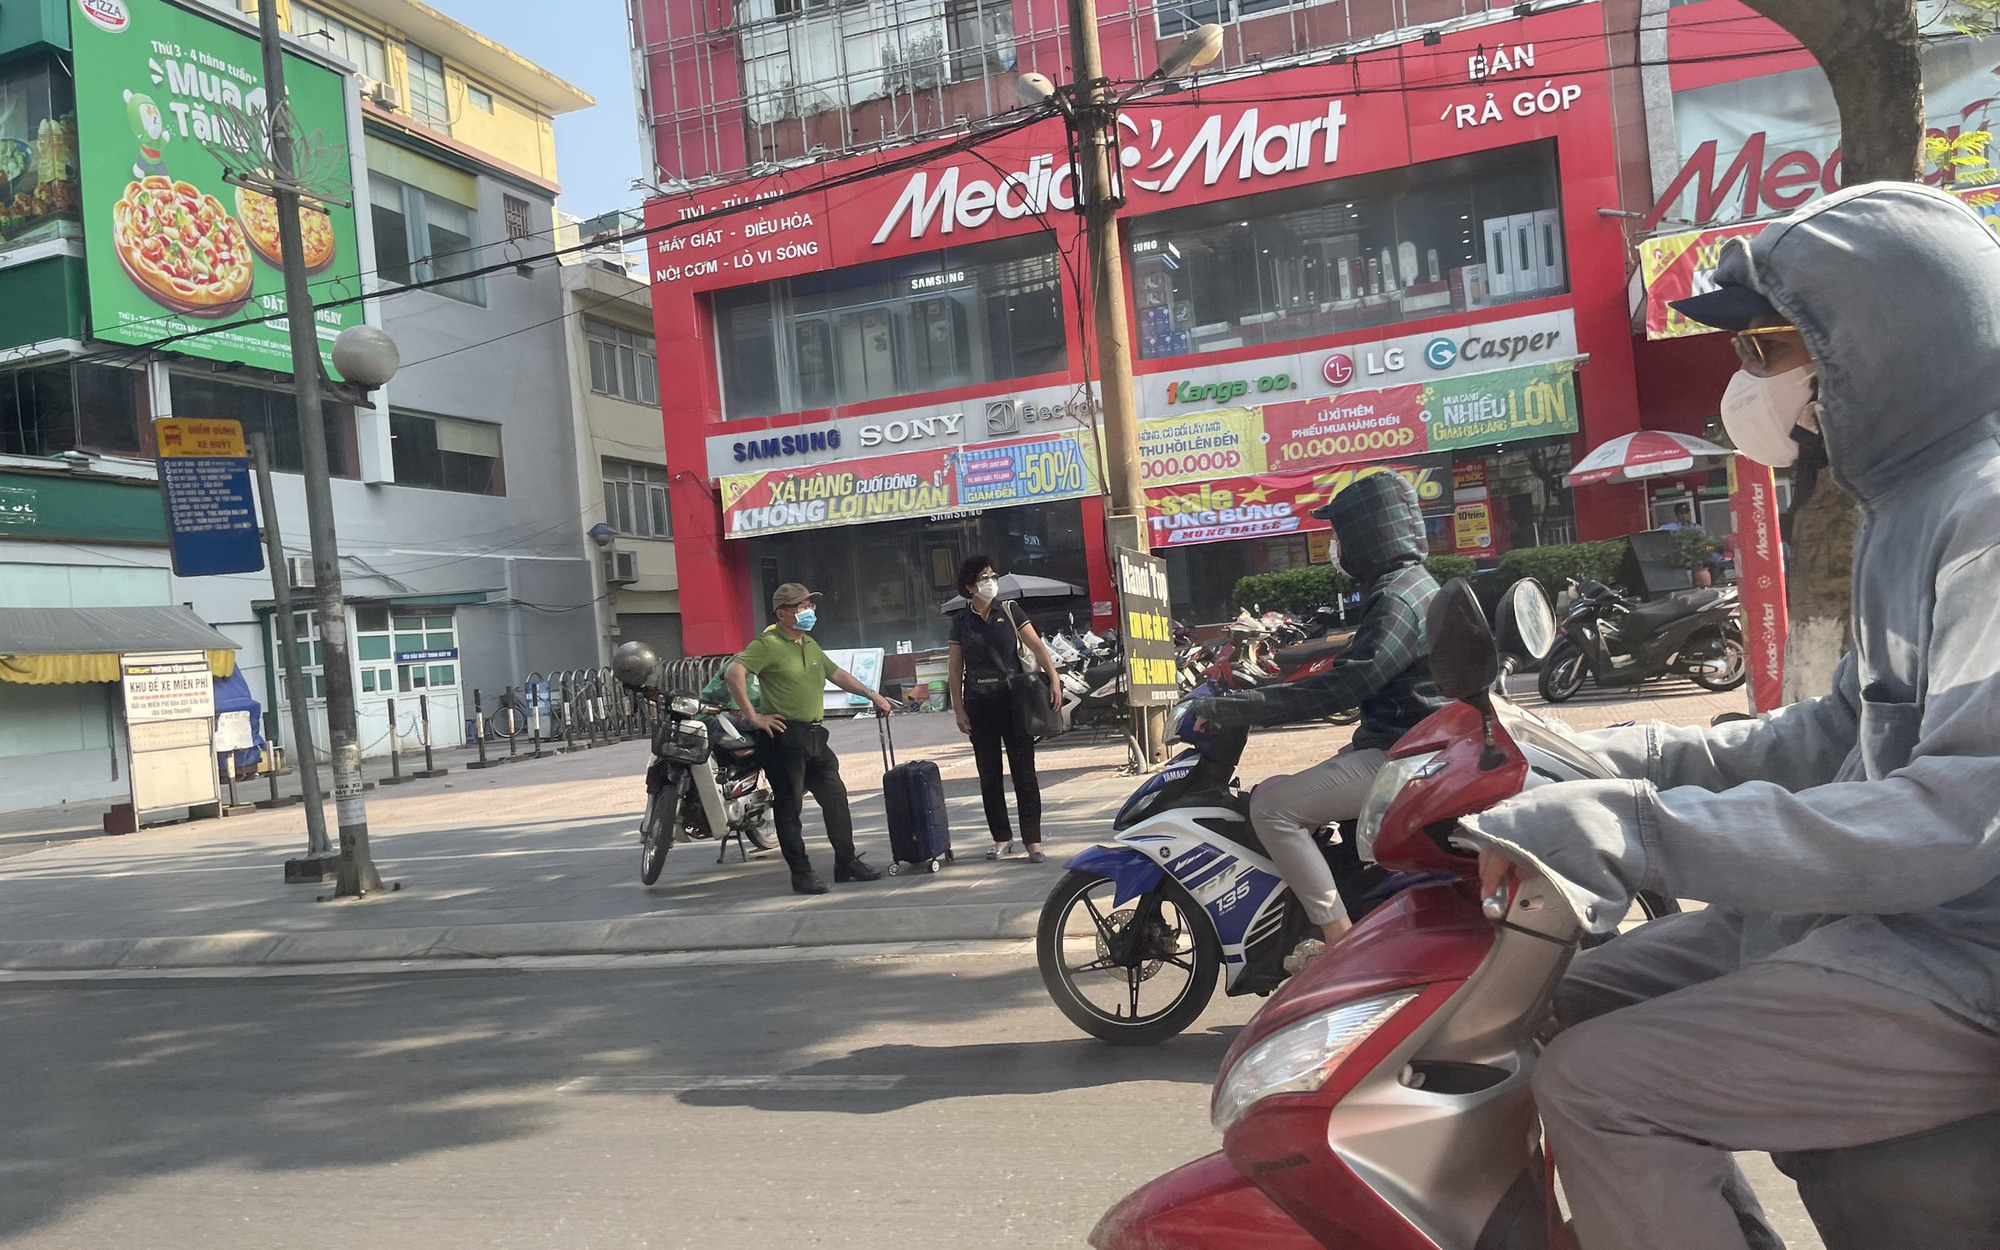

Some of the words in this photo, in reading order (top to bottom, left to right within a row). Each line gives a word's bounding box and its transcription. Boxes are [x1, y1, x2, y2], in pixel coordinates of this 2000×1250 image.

[151, 40, 174, 57] Thứ
[174, 44, 182, 58] 3
[190, 49, 198, 62] 4
[199, 51, 226, 71] hàng
[1467, 43, 1535, 80] BÁN
[164, 59, 242, 111] Mua
[1512, 80, 1582, 117] GÓP
[1159, 100, 1347, 193] Mart
[678, 204, 706, 221] TIVI
[658, 235, 687, 254] MÁY
[690, 229, 724, 248] GIẶT
[744, 216, 778, 238] ĐIỀU
[781, 211, 813, 231] HÒA
[684, 260, 718, 278] CƠM
[733, 249, 754, 269] LÒ
[756, 251, 772, 265] VI
[776, 241, 819, 261] SÓNG
[910, 271, 965, 290] SAMSUNG
[263, 294, 284, 313] ĐẶT
[316, 309, 342, 326] NGAY
[1366, 346, 1405, 376] LG
[1459, 327, 1560, 364] Casper
[1341, 403, 1374, 418] THÊM
[1443, 395, 1460, 405] MUA
[1460, 391, 1479, 402] CÀNG
[1443, 393, 1507, 426] NHIỀU
[1508, 376, 1568, 429] LỚN
[858, 413, 965, 448] SONY
[1189, 422, 1205, 435] LẤY
[1291, 423, 1323, 439] PHIẾU
[1324, 424, 1347, 436] MUA
[1347, 418, 1378, 432] HÀNG
[1378, 412, 1400, 427] ĐẾN
[733, 428, 841, 463] SAMSUNG
[1139, 444, 1164, 458] THU
[1165, 439, 1187, 454] HỒI
[1188, 436, 1211, 450] LÊN
[1213, 430, 1239, 447] ĐẾN
[1280, 427, 1415, 462] 10.000.000Đ
[1018, 448, 1081, 495] -50%
[769, 475, 796, 504] XẢ
[799, 472, 853, 501] HÀNG
[856, 474, 883, 494] CUỐI
[884, 473, 917, 492] ĐÔNG
[967, 488, 995, 502] GIẢM
[995, 483, 1017, 499] ĐẾN
[1160, 483, 1234, 516] sale
[1751, 482, 1765, 511] Mart
[732, 499, 825, 533] KHÔNG
[867, 481, 950, 514] NHUẬN
[1458, 511, 1467, 520] 10
[1024, 533, 1041, 546] SONY
[1756, 522, 1770, 561] Media
[1120, 554, 1151, 598] Hanoi
[1149, 562, 1169, 608] Top
[1761, 603, 1775, 632] Mart
[1766, 643, 1779, 681] Media
[129, 681, 147, 693] KHU
[161, 679, 172, 691] XE
[195, 674, 209, 689] PHÍ
[1162, 769, 1190, 783] YAMAHA
[1215, 879, 1251, 913] 135
